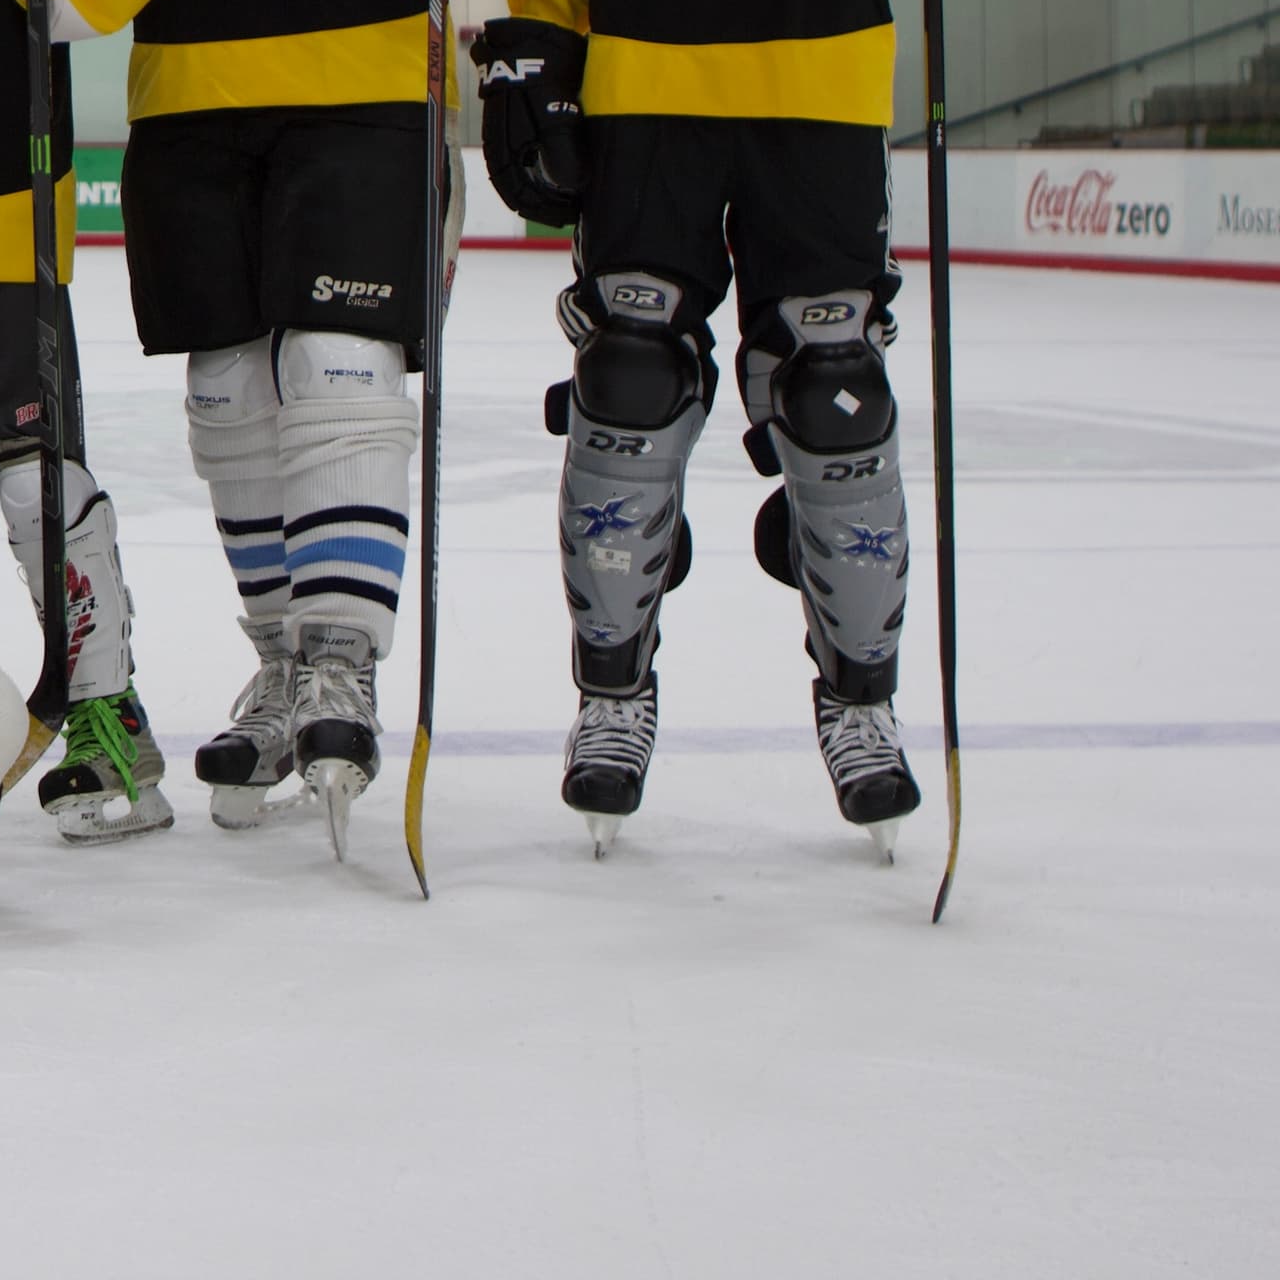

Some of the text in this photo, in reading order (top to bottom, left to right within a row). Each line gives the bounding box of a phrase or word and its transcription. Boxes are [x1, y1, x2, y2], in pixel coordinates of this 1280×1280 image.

[1115, 202, 1171, 236] zero
[312, 274, 393, 302] Supra
[614, 289, 662, 305] DR
[802, 307, 851, 323] DR
[324, 369, 373, 377] NEXUS
[192, 393, 231, 403] NEXUS
[38, 319, 61, 519] CCM
[585, 431, 648, 455] DR
[822, 457, 881, 480] DR
